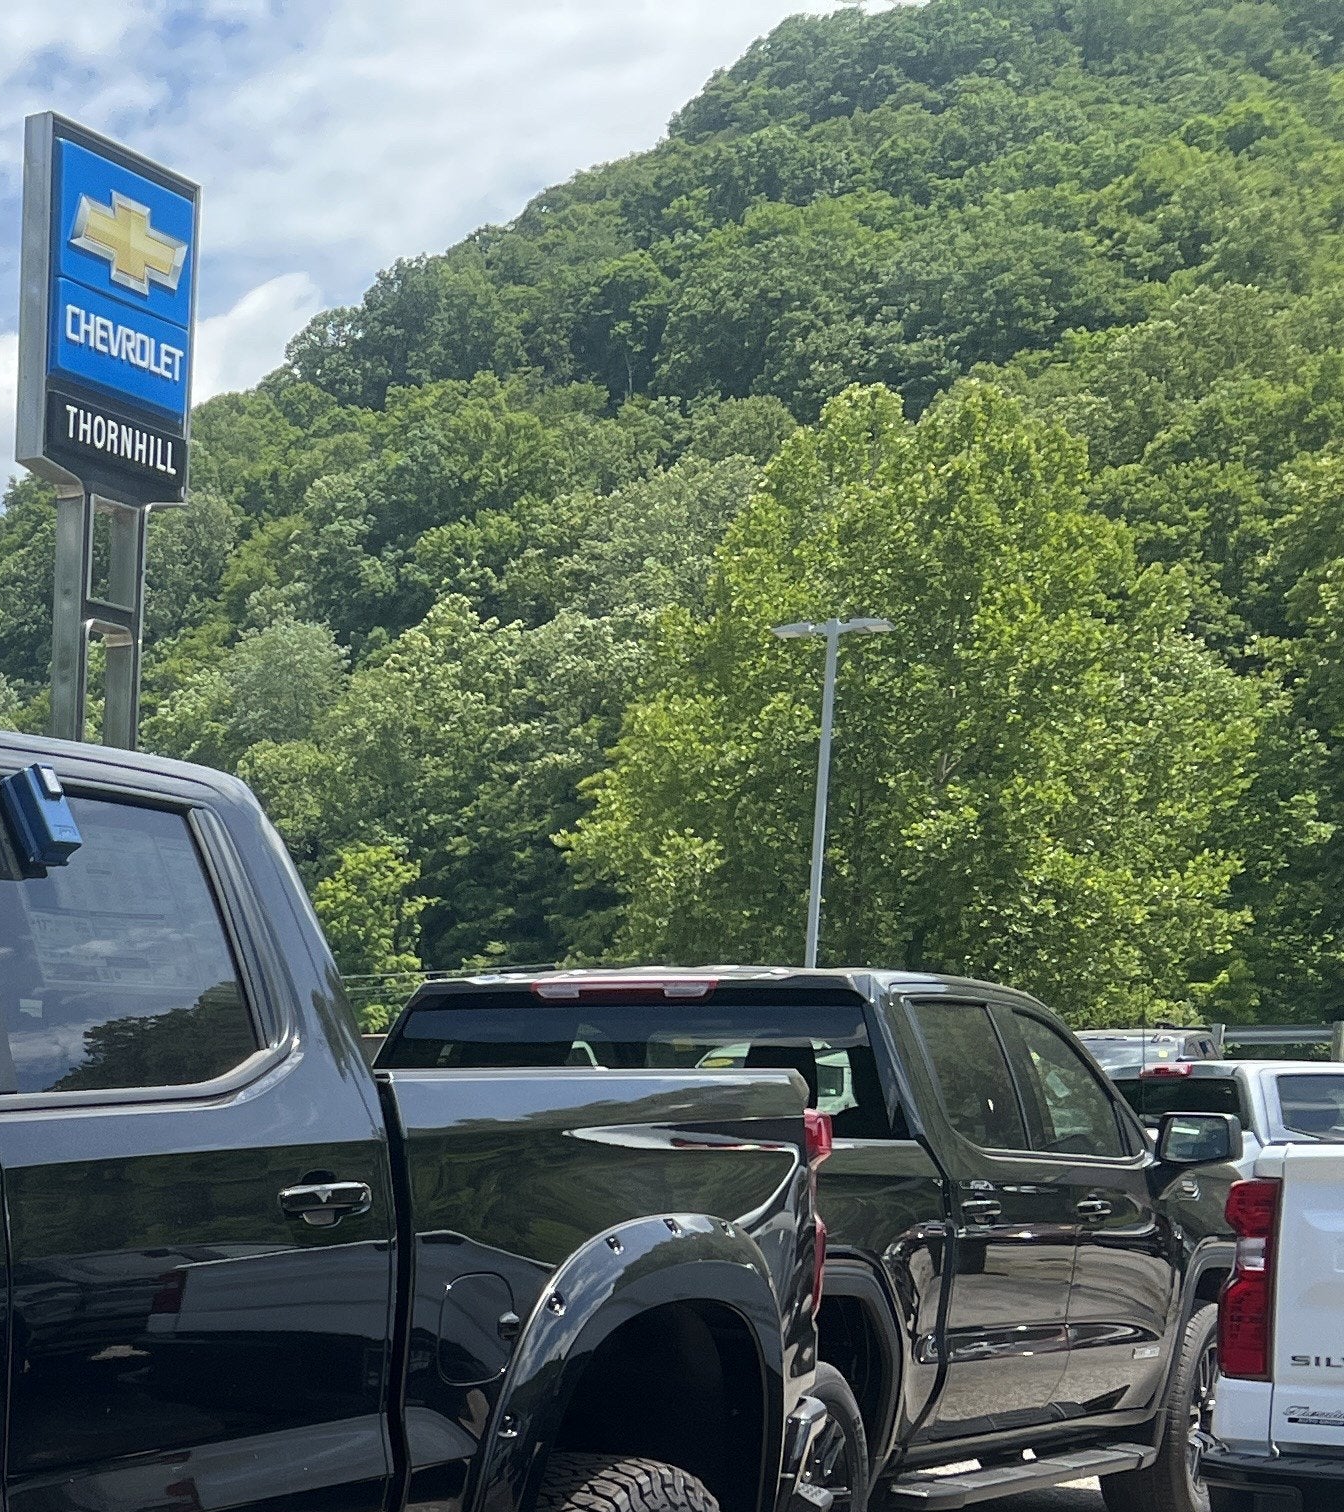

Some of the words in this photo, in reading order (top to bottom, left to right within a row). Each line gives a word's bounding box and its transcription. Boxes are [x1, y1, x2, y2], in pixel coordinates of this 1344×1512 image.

[65, 304, 184, 382] CHEVROLET
[65, 404, 176, 475] THORNHILL
[1291, 1355, 1344, 1369] SIL
